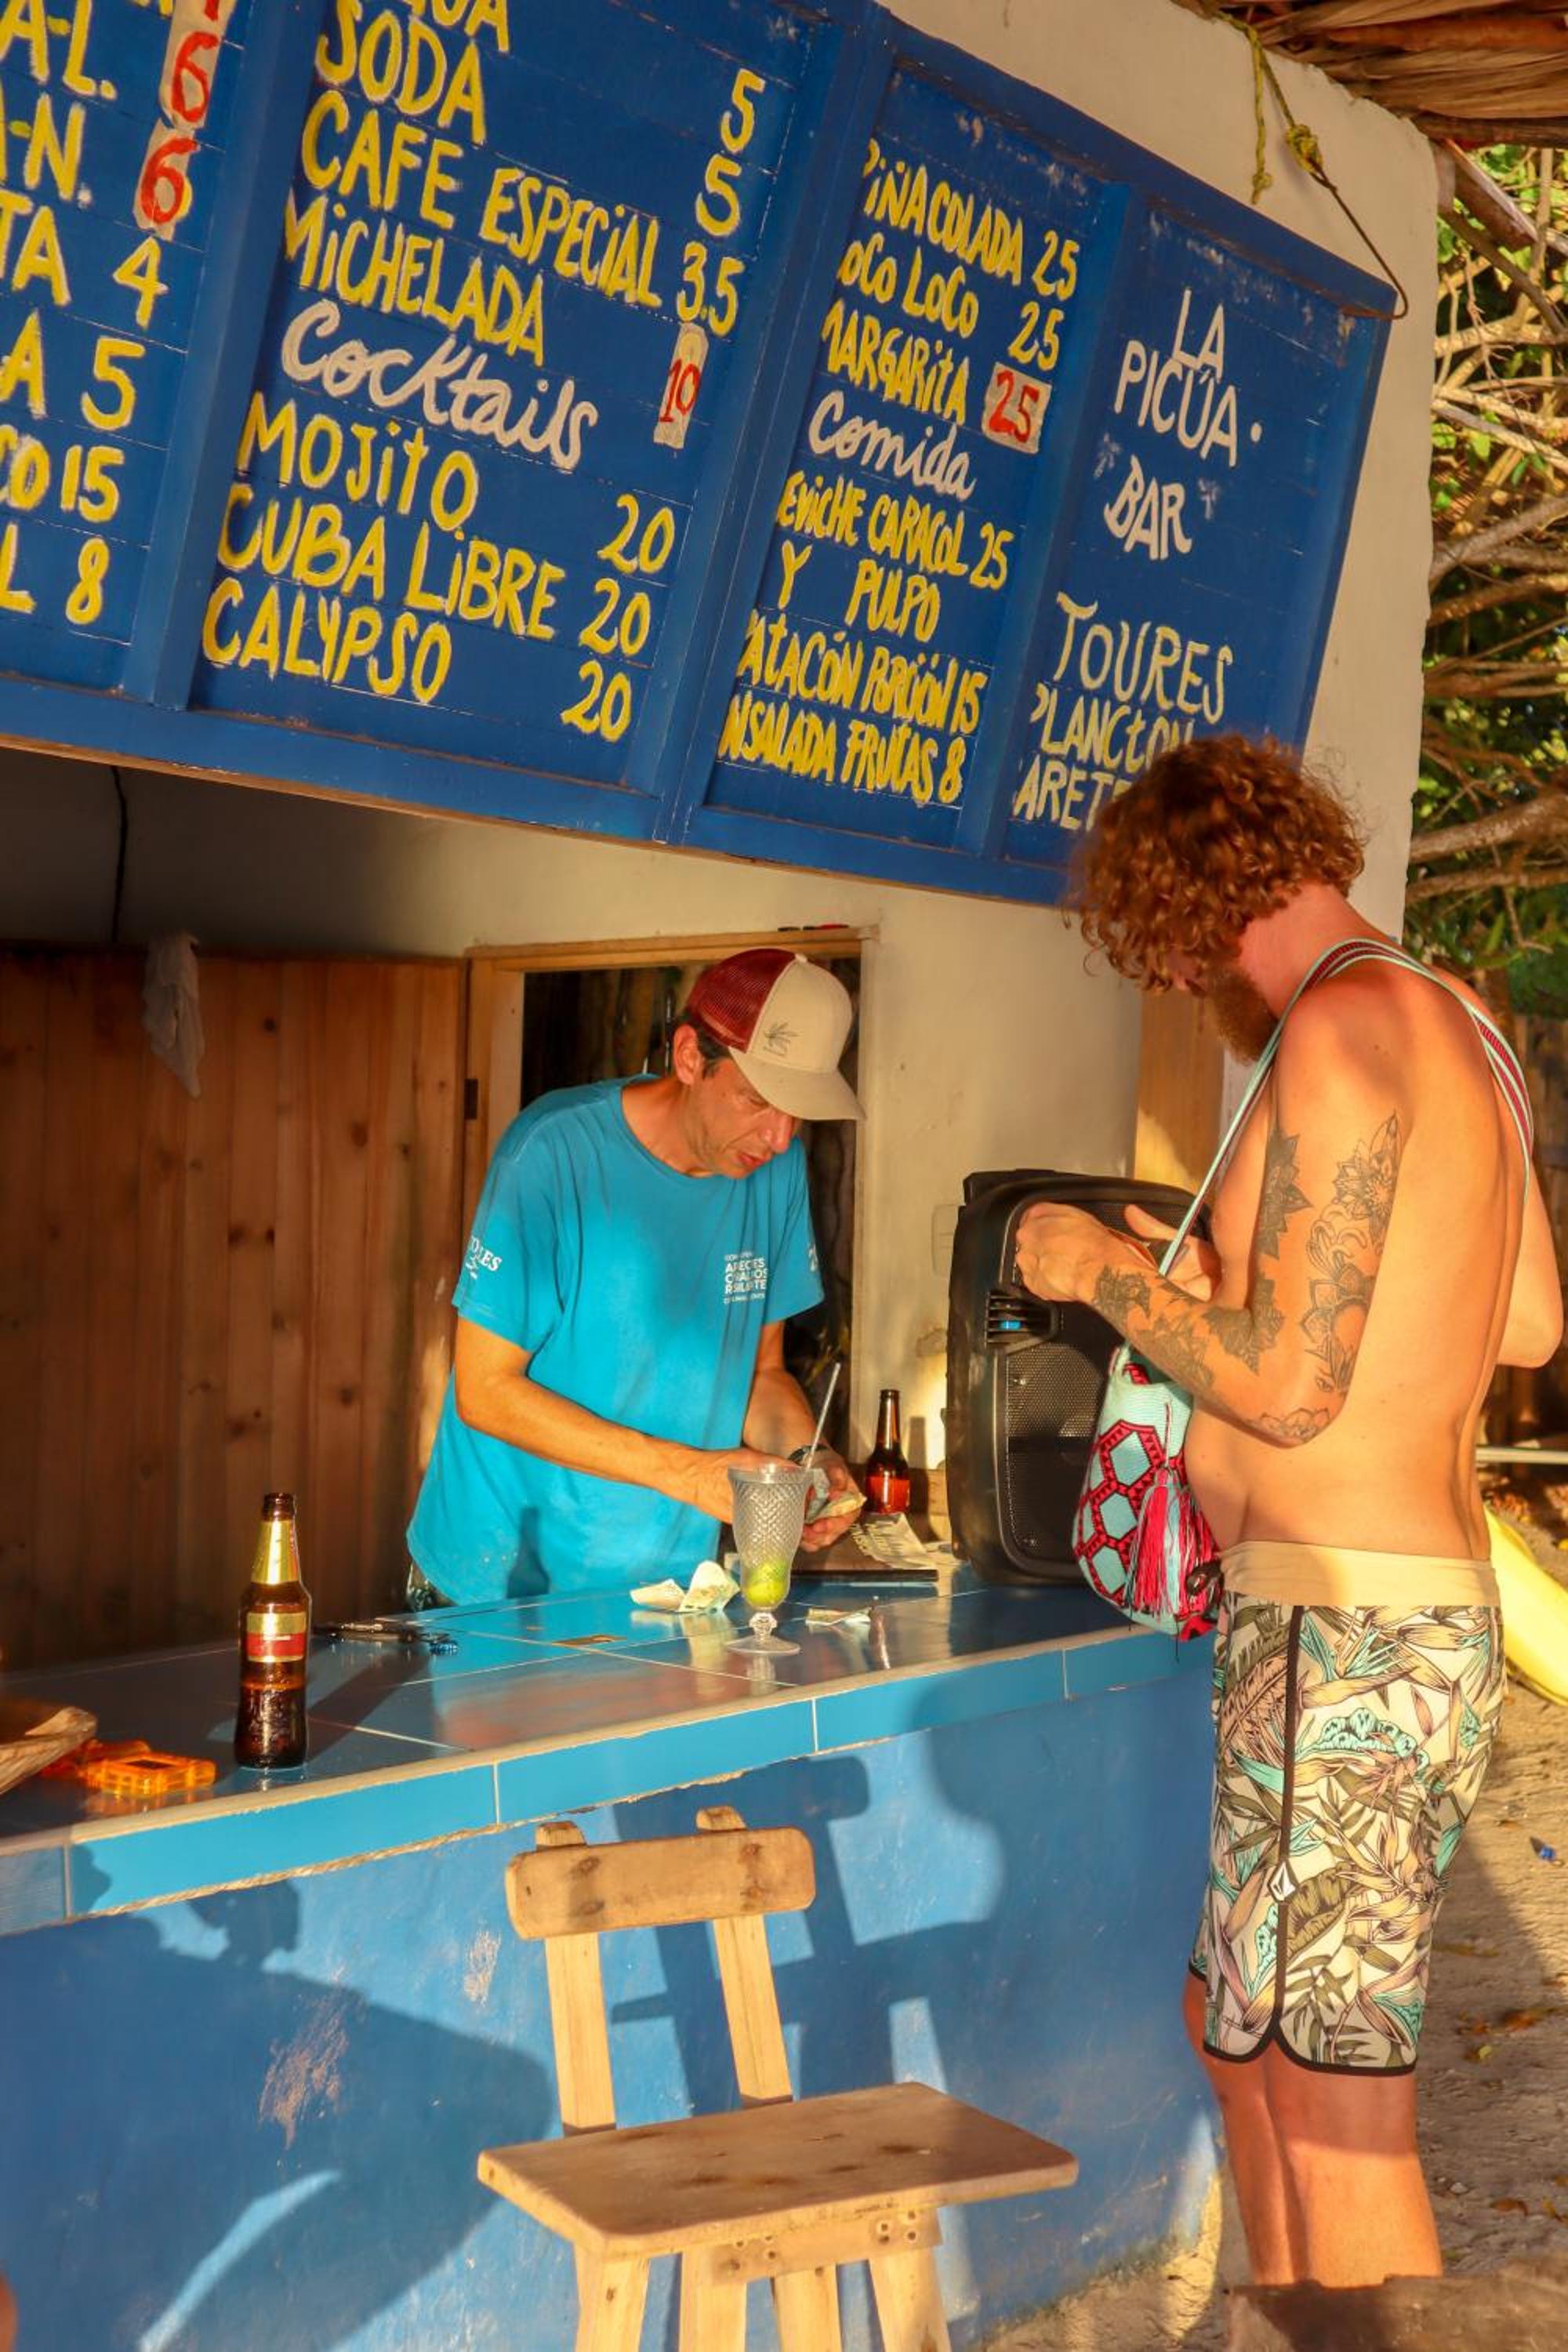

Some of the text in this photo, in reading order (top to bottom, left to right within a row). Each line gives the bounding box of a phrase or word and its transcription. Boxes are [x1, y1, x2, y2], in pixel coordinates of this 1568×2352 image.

[171, 31, 220, 123] 6
[315, 0, 486, 146] SODA
[720, 67, 766, 154] 5
[140, 136, 198, 224] 6
[301, 89, 464, 230] CAFE
[695, 154, 742, 236] 5
[113, 236, 169, 330] 4
[677, 241, 746, 337] 3.5
[1032, 230, 1079, 301] 25
[1008, 301, 1064, 370] 25
[1172, 287, 1225, 384] LA
[82, 336, 146, 431] 5
[659, 358, 701, 423] 10
[989, 370, 1039, 444] 25
[60, 445, 125, 523] 15
[808, 390, 978, 500] Comida
[598, 493, 675, 575] 20
[868, 494, 969, 577] CARACOL
[969, 521, 1014, 590] 25
[1103, 454, 1192, 561] BAR
[66, 537, 109, 625] 8
[217, 483, 386, 602] CUBA
[579, 577, 650, 657] 20
[778, 539, 941, 643] Y PULPO
[202, 577, 631, 742] CALYPSO 20
[949, 668, 989, 736] 15
[1053, 590, 1234, 725] TOURES
[937, 735, 966, 804] 8
